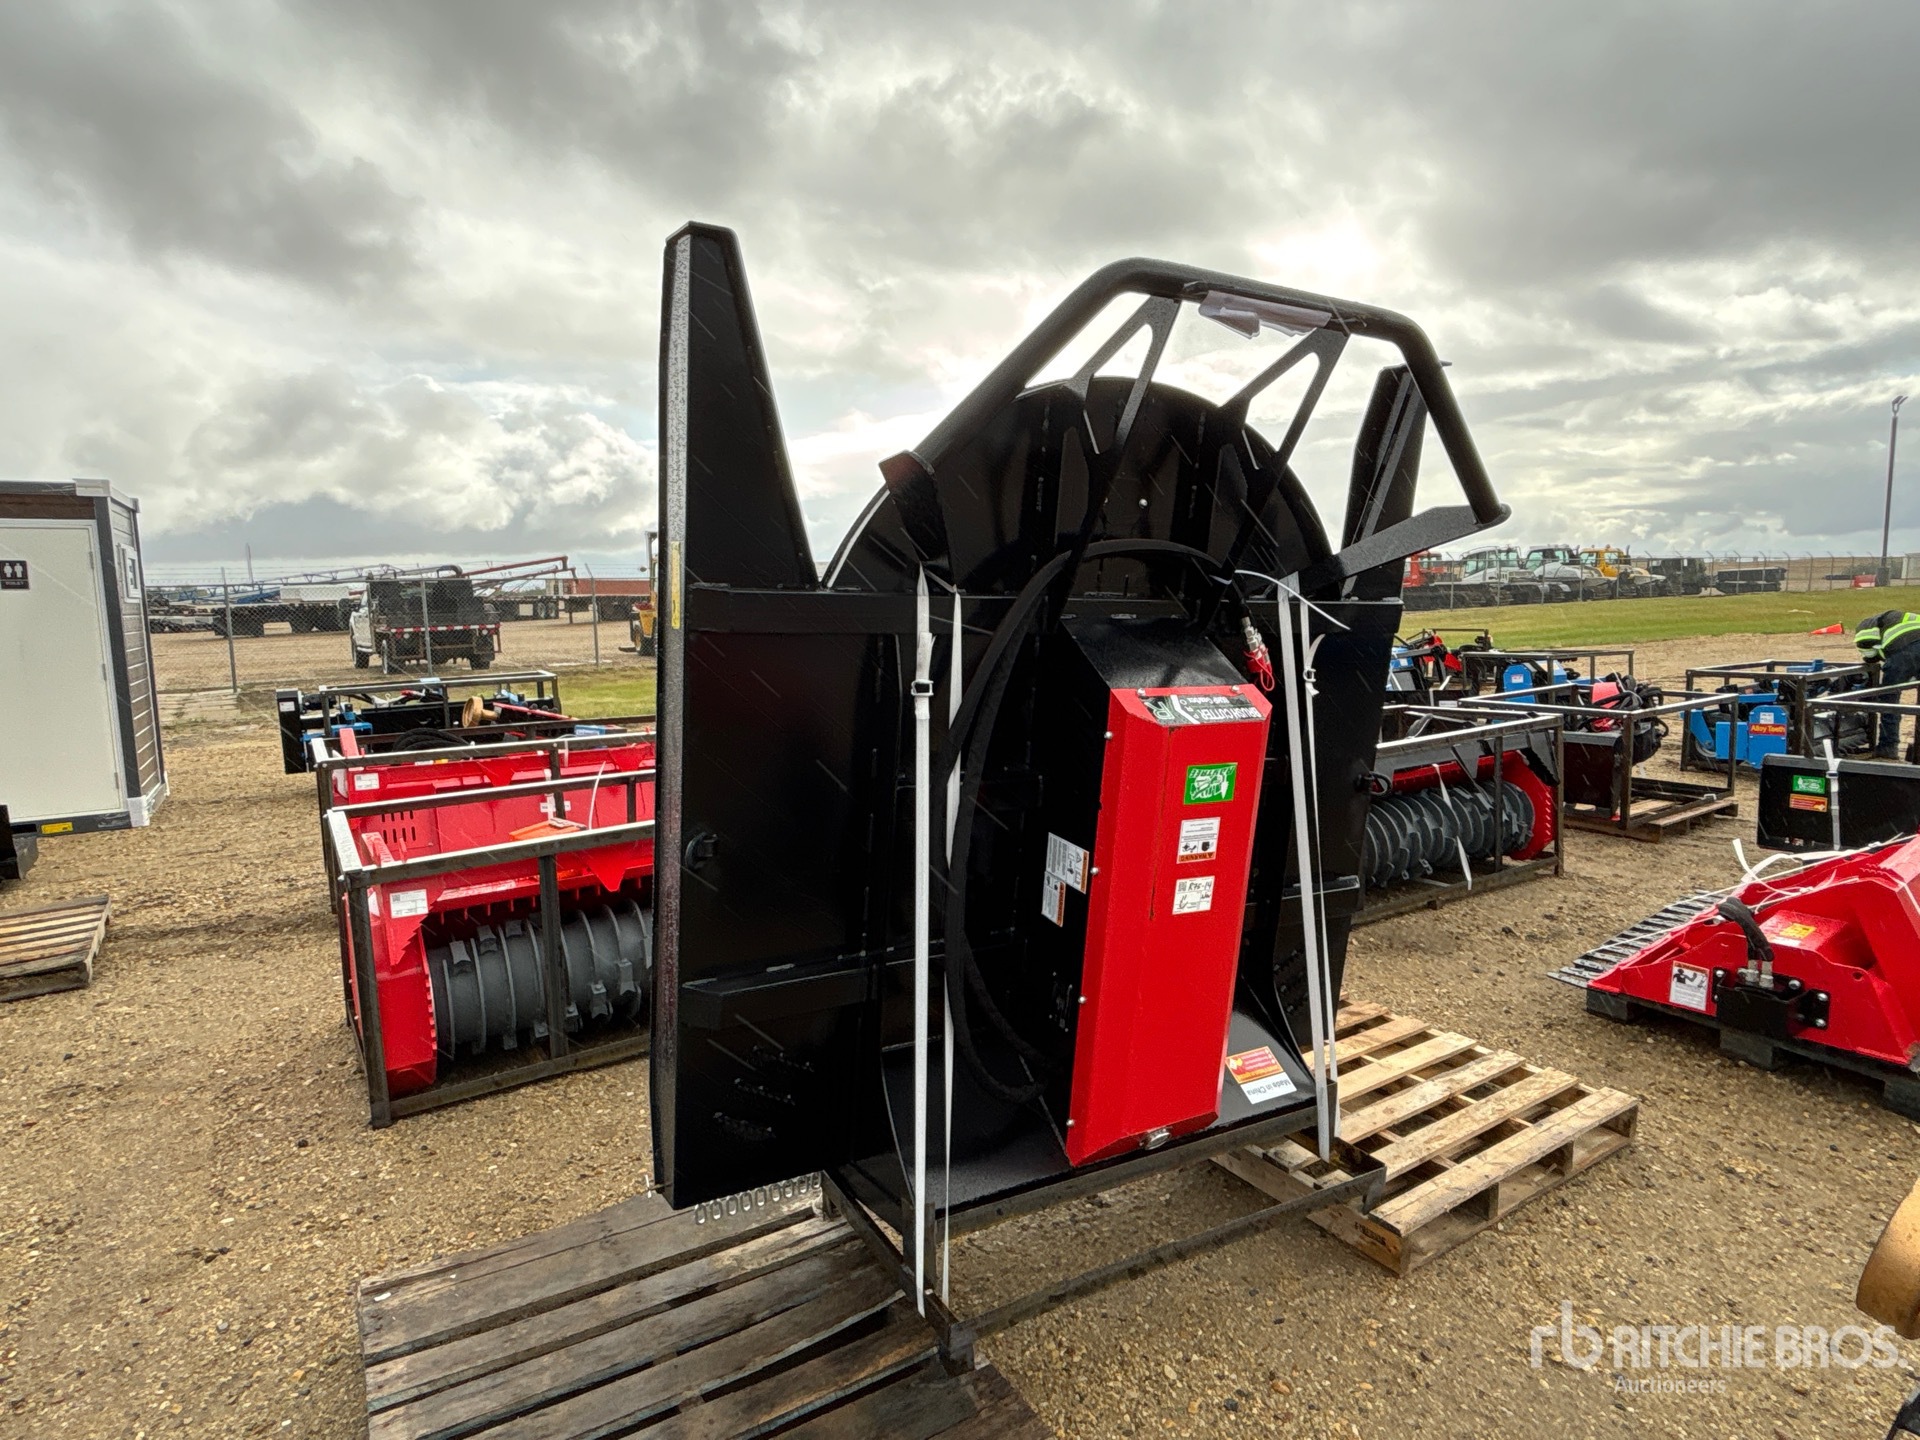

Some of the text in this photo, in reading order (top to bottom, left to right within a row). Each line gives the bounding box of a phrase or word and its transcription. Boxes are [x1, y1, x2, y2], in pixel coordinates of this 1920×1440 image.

[1199, 706, 1262, 720] BRUSH CUTTER
[1750, 724, 1785, 734] Alloy Teeth
[1271, 1079, 1291, 1090] Made
[1246, 1086, 1267, 1096] China
